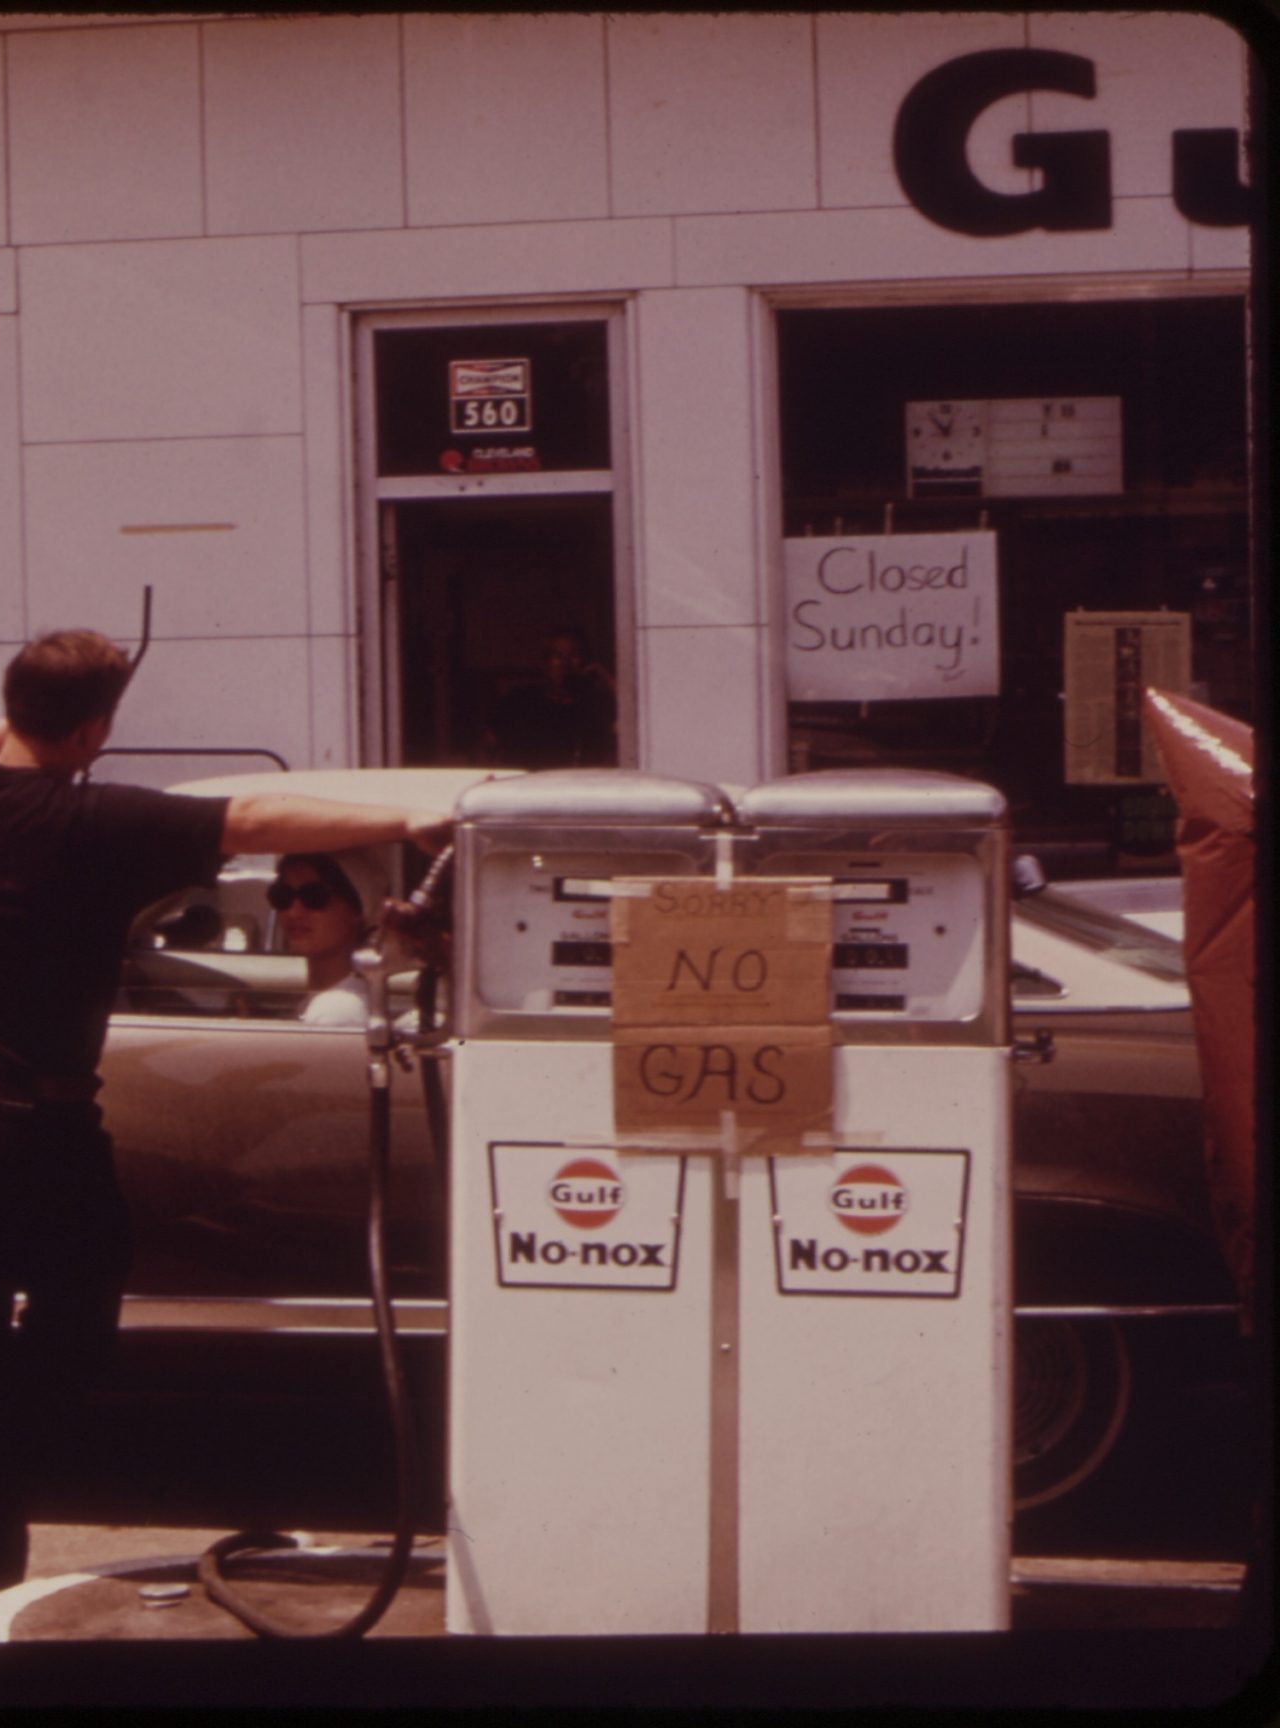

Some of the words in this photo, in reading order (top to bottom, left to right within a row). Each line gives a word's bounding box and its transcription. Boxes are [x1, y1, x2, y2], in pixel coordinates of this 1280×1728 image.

[463, 400, 518, 427] 560
[817, 546, 968, 595] Closed
[792, 596, 981, 671] Sunday!
[666, 947, 768, 992] NO
[639, 1043, 786, 1104] GAS
[551, 1183, 622, 1205] Gulf
[832, 1189, 906, 1210] Gulf
[510, 1231, 667, 1268] No-nox
[789, 1238, 950, 1275] No-nox
